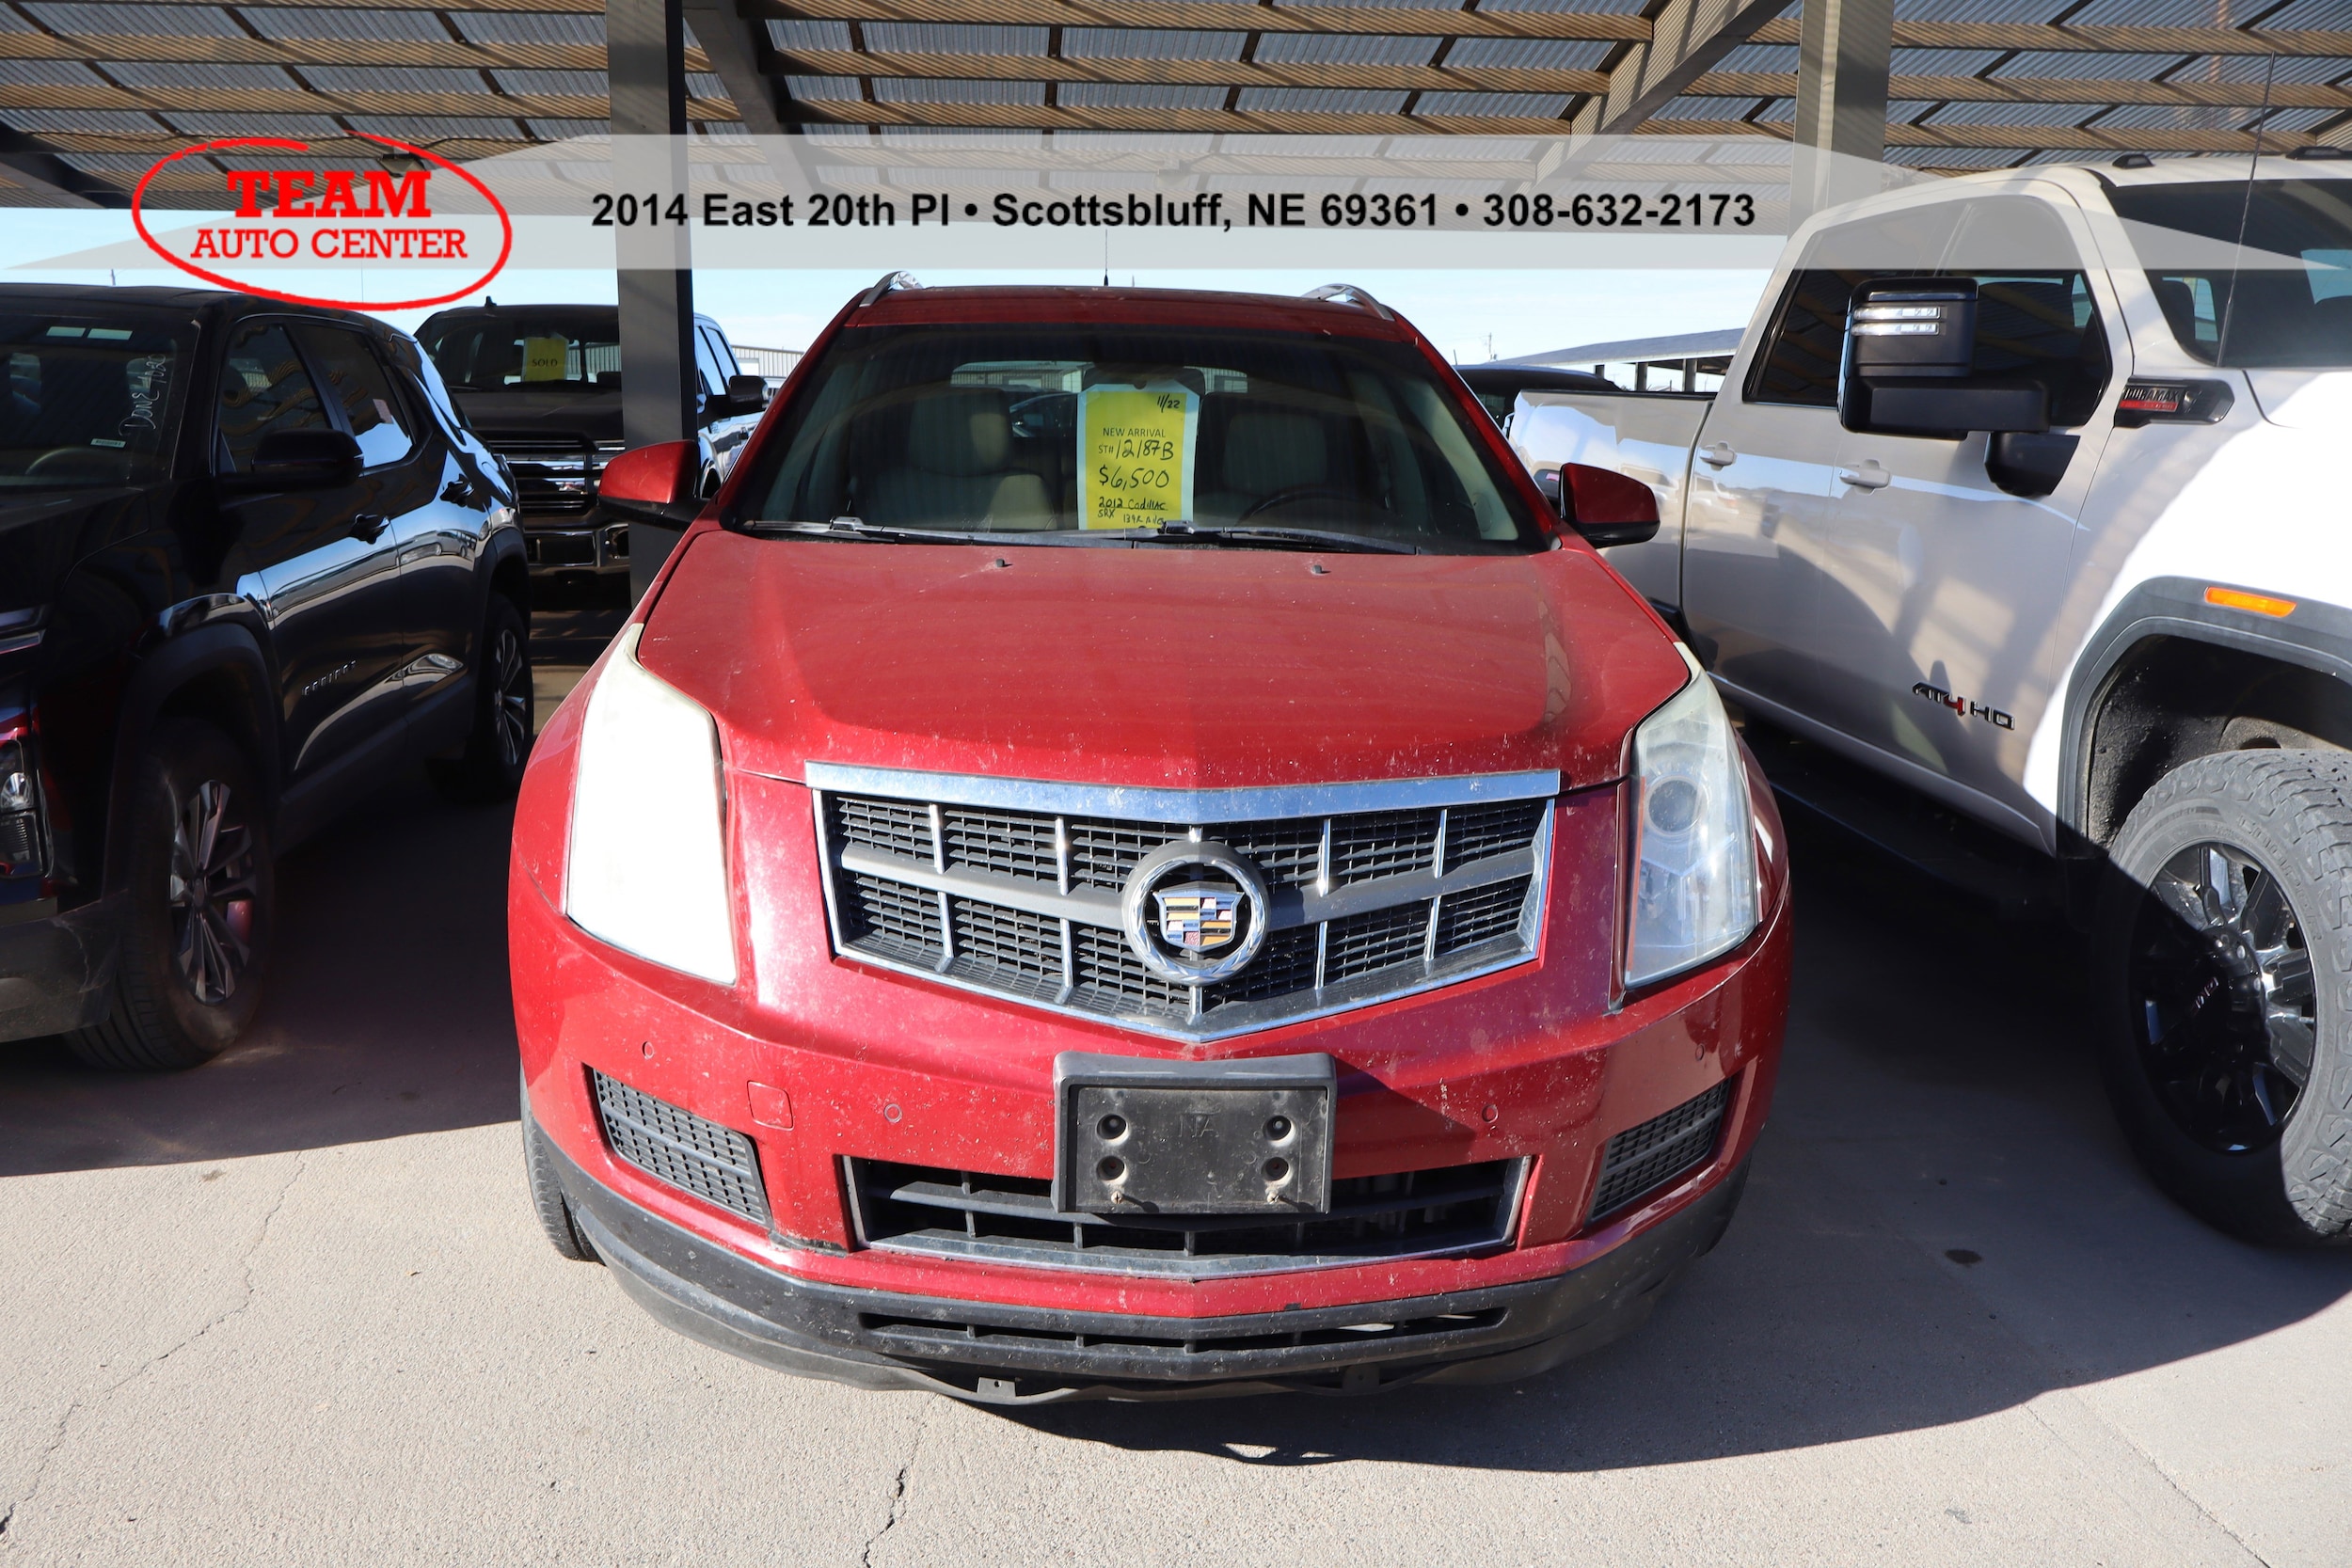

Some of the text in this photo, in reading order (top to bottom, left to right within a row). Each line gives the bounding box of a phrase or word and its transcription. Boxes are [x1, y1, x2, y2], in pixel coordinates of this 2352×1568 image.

[532, 357, 559, 368] SOLD
[1156, 393, 1181, 413] 11/22
[1103, 427, 1166, 437] NEW ARRIVAL
[1099, 465, 1169, 491] $6,500
[1098, 497, 1123, 508] 2012
[1097, 508, 1116, 519] SRX
